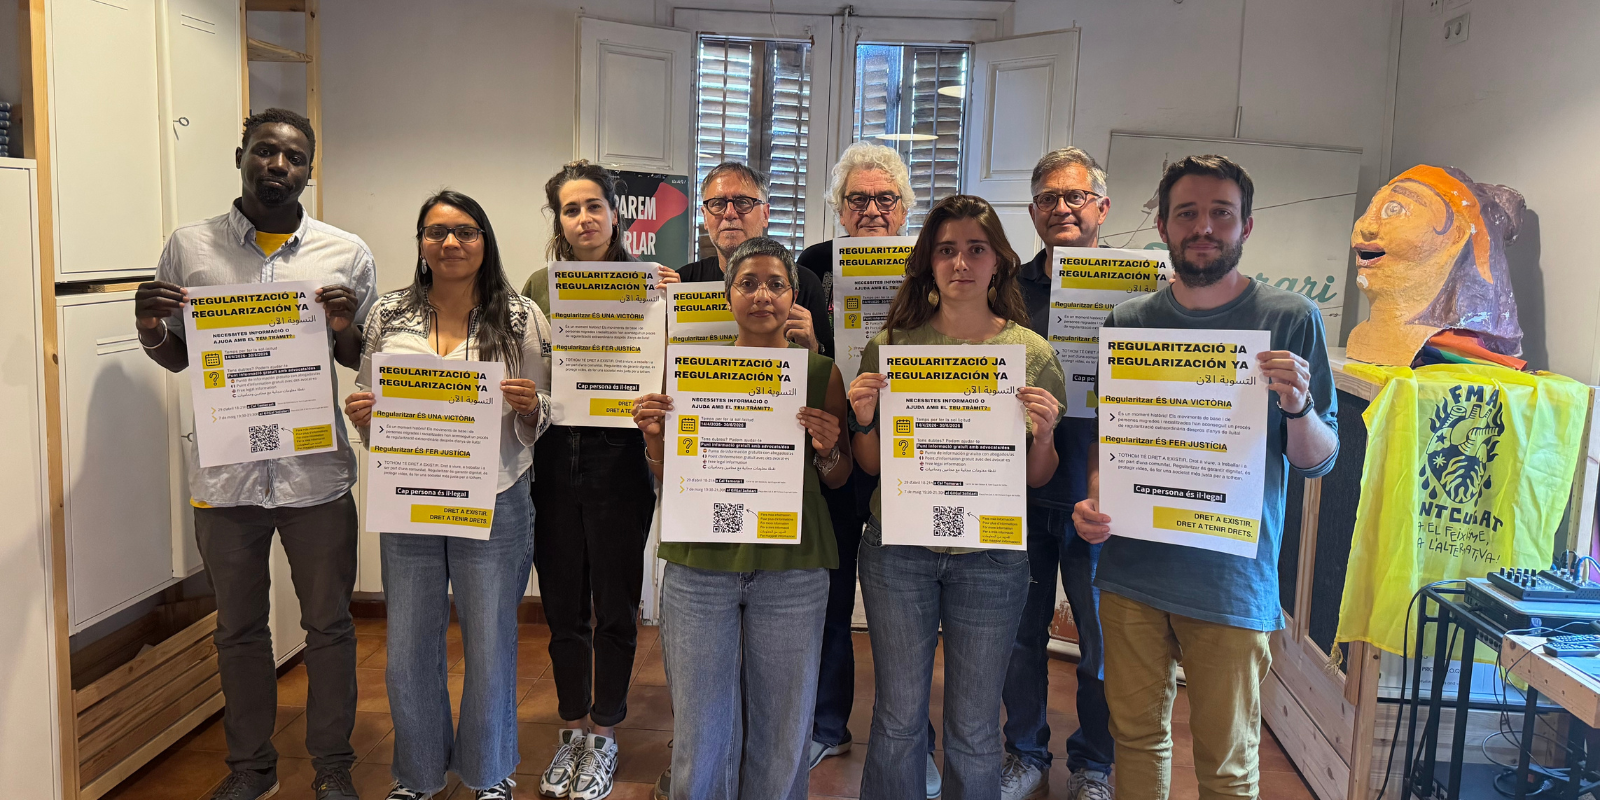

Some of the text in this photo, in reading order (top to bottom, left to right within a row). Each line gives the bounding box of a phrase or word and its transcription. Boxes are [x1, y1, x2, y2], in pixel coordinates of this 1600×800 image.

[623, 231, 656, 256] RLAR
[839, 247, 913, 255] REGULARITZACI
[1060, 258, 1150, 268] REGULARITZACIÓ
[555, 271, 639, 279] REGULARITZACIÓ
[1059, 270, 1150, 280] REGULARIZACIÓN
[190, 292, 289, 306] REGULARITZACIÓ
[673, 292, 725, 300] REGULARIT
[192, 304, 291, 318] REGULARIZACIÓN
[674, 304, 727, 312] REGULARIZ
[1108, 342, 1247, 354] REGULARITZACIÓ JA
[675, 357, 773, 368] REGULARITZACIÓ
[887, 357, 988, 366] REGULARITZACIÓ
[1108, 357, 1248, 369] REGULARIZACIÓN YA
[379, 366, 471, 379] REGULARITZACIÓ
[674, 371, 773, 381] REGULARIZACIÓN
[887, 370, 989, 380] REGULARIZACIÓN
[379, 378, 471, 391] REGULARIZACIÓN
[1105, 395, 1153, 404] Regularitzar
[1191, 399, 1232, 407] VICTÒRIA
[377, 410, 416, 418] Regularitzar
[1105, 435, 1153, 444] Regularitzar
[1155, 437, 1167, 445] ÉS
[1188, 441, 1228, 451] JUSTÍCIA
[1135, 485, 1223, 502] Cap persona és il·legal
[1194, 513, 1214, 521] DRET
[1223, 517, 1252, 528] EXISTIR.
[1176, 520, 1196, 528] DRET
[1204, 524, 1226, 532] TENIR
[1228, 527, 1253, 538] DRETS.
[1428, 522, 1440, 535] EL
